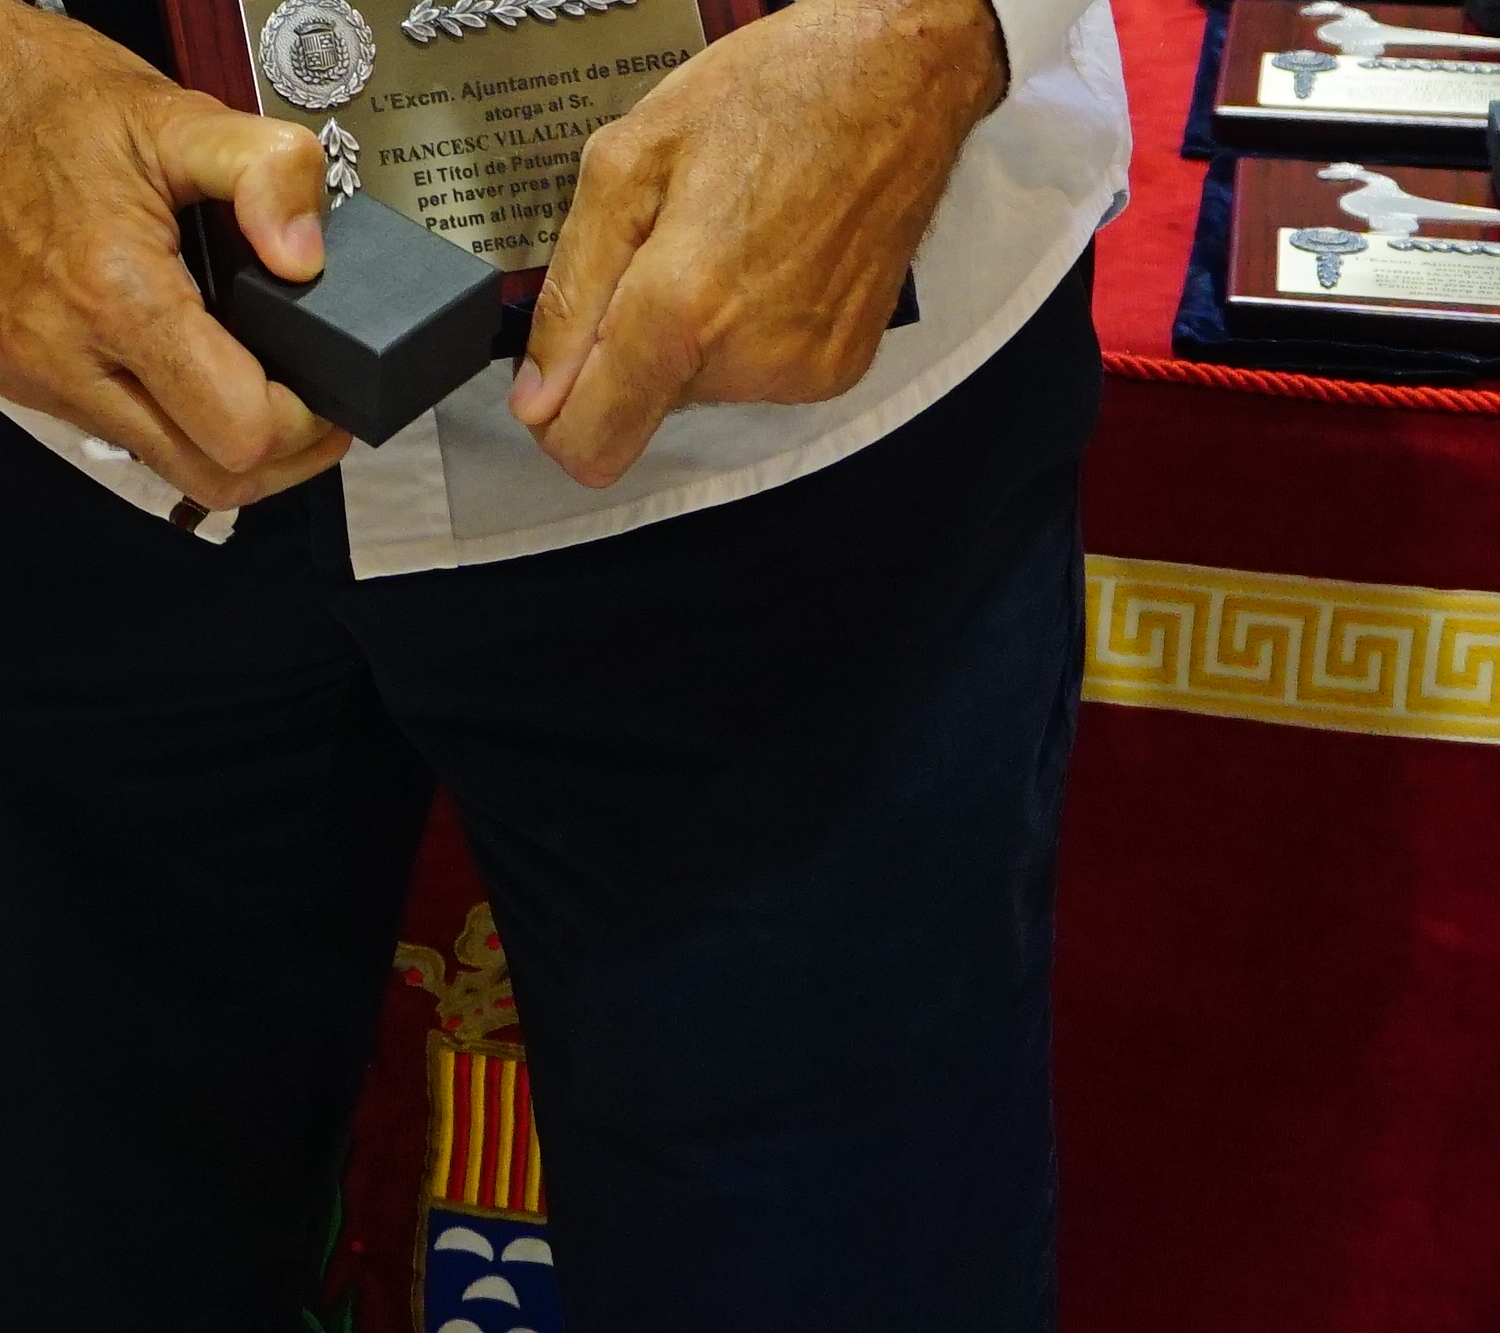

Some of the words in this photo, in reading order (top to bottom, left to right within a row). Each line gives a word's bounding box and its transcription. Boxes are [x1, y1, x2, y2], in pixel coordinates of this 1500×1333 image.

[370, 89, 455, 113] L'Excm.
[461, 67, 582, 102] Ajuntament
[586, 63, 610, 80] de
[615, 49, 692, 76] BERGA
[485, 102, 544, 122] atorga
[549, 97, 564, 112] al
[569, 93, 594, 110] Sr.
[378, 134, 489, 166] FRANCESC
[494, 121, 583, 147] VILALTA
[414, 170, 432, 187] El
[485, 161, 508, 175] de
[511, 148, 582, 171] Patuma
[417, 193, 447, 212] per
[453, 184, 504, 203] haver
[510, 178, 550, 197] pres
[426, 213, 485, 231] Patum
[490, 207, 506, 223] al
[511, 203, 553, 219] llarg
[472, 233, 534, 254] BERGA,
